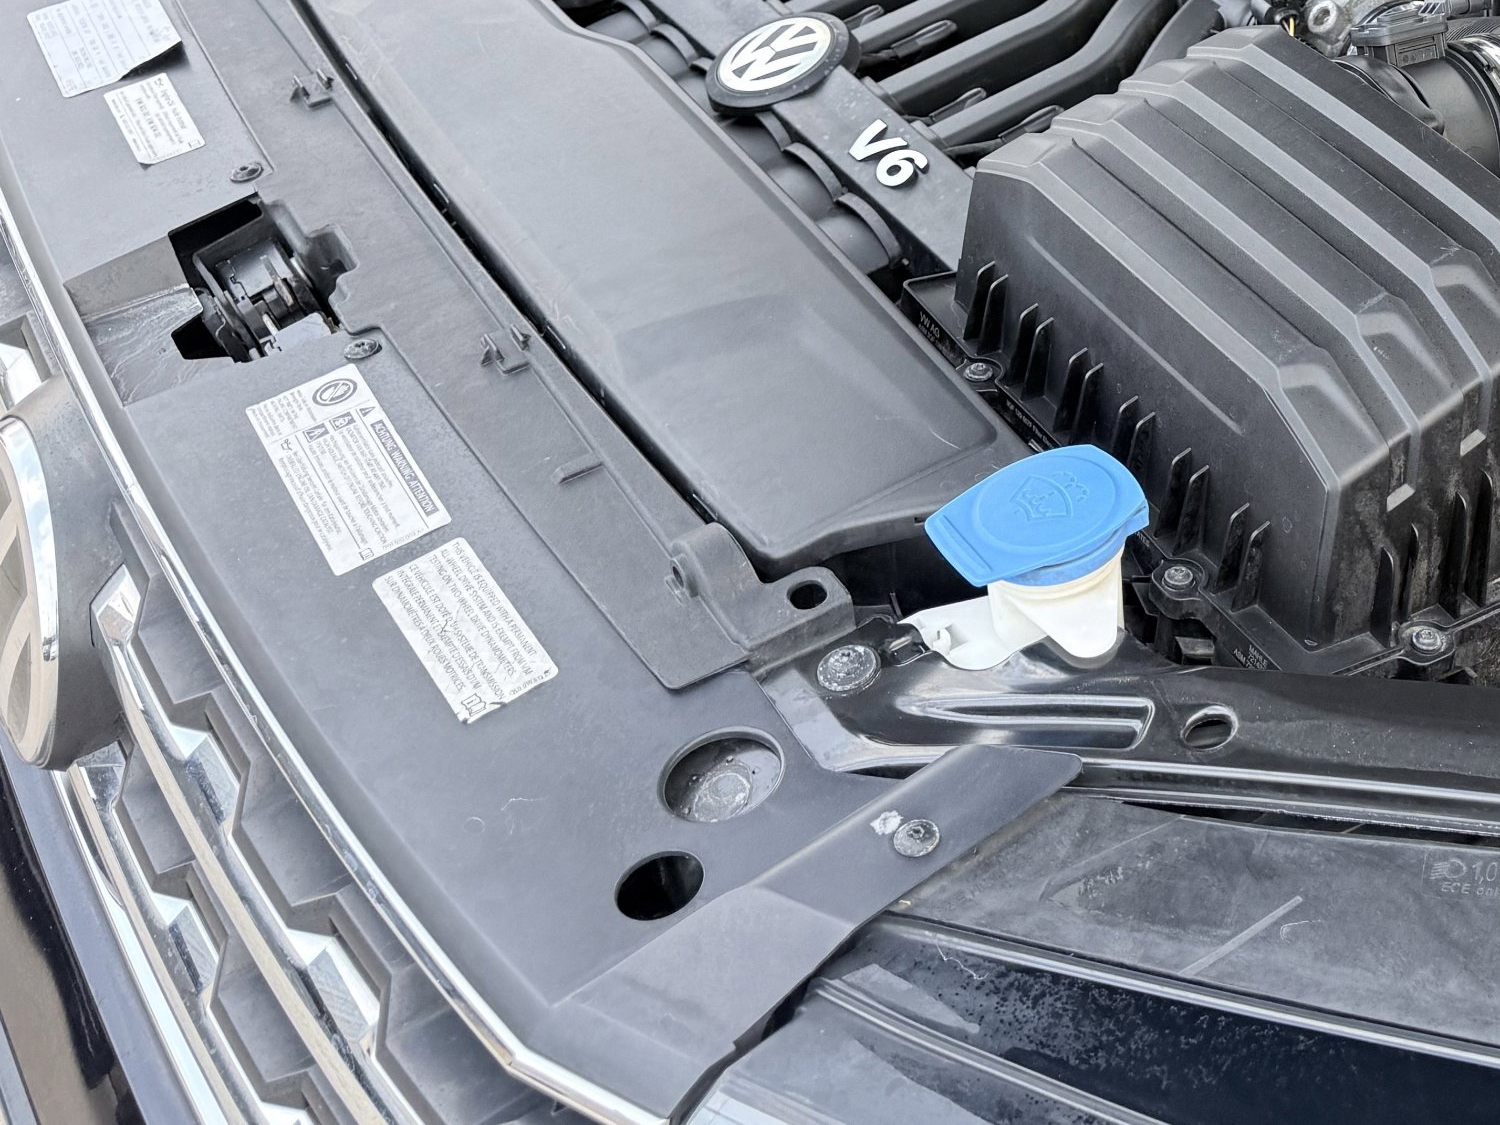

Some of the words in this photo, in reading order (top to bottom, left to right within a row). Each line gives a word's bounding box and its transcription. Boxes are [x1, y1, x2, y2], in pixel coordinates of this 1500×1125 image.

[849, 118, 930, 188] V6
[372, 421, 397, 451] ACHTUNG
[389, 448, 415, 480] WARNING
[407, 478, 435, 513] ATTENTION
[450, 541, 464, 555] THIS
[408, 563, 419, 571] CE
[458, 553, 479, 575] VEHICLE
[457, 574, 474, 592] DRIVE
[472, 572, 483, 580] IS
[427, 553, 447, 576] TESTING
[440, 573, 453, 585] ON
[469, 614, 486, 632] DRIVE
[428, 592, 441, 604] EST
[468, 589, 488, 611] SYSTEM
[476, 578, 501, 606] EQUIPPED
[384, 574, 398, 587] SUR
[419, 629, 435, 646] DEUX
[429, 644, 447, 664] ROUES
[412, 594, 439, 626] PERMANENT
[481, 608, 496, 623] AND
[495, 604, 511, 621] WITH
[490, 620, 500, 629] IS
[504, 617, 515, 625] A
[494, 626, 515, 650] EXEMPT
[508, 622, 538, 657] PERMANENT
[467, 650, 480, 662] DE
[508, 647, 526, 665] FROM
[472, 658, 506, 701] TRANSMISSION
[1441, 881, 1471, 895] ECE
